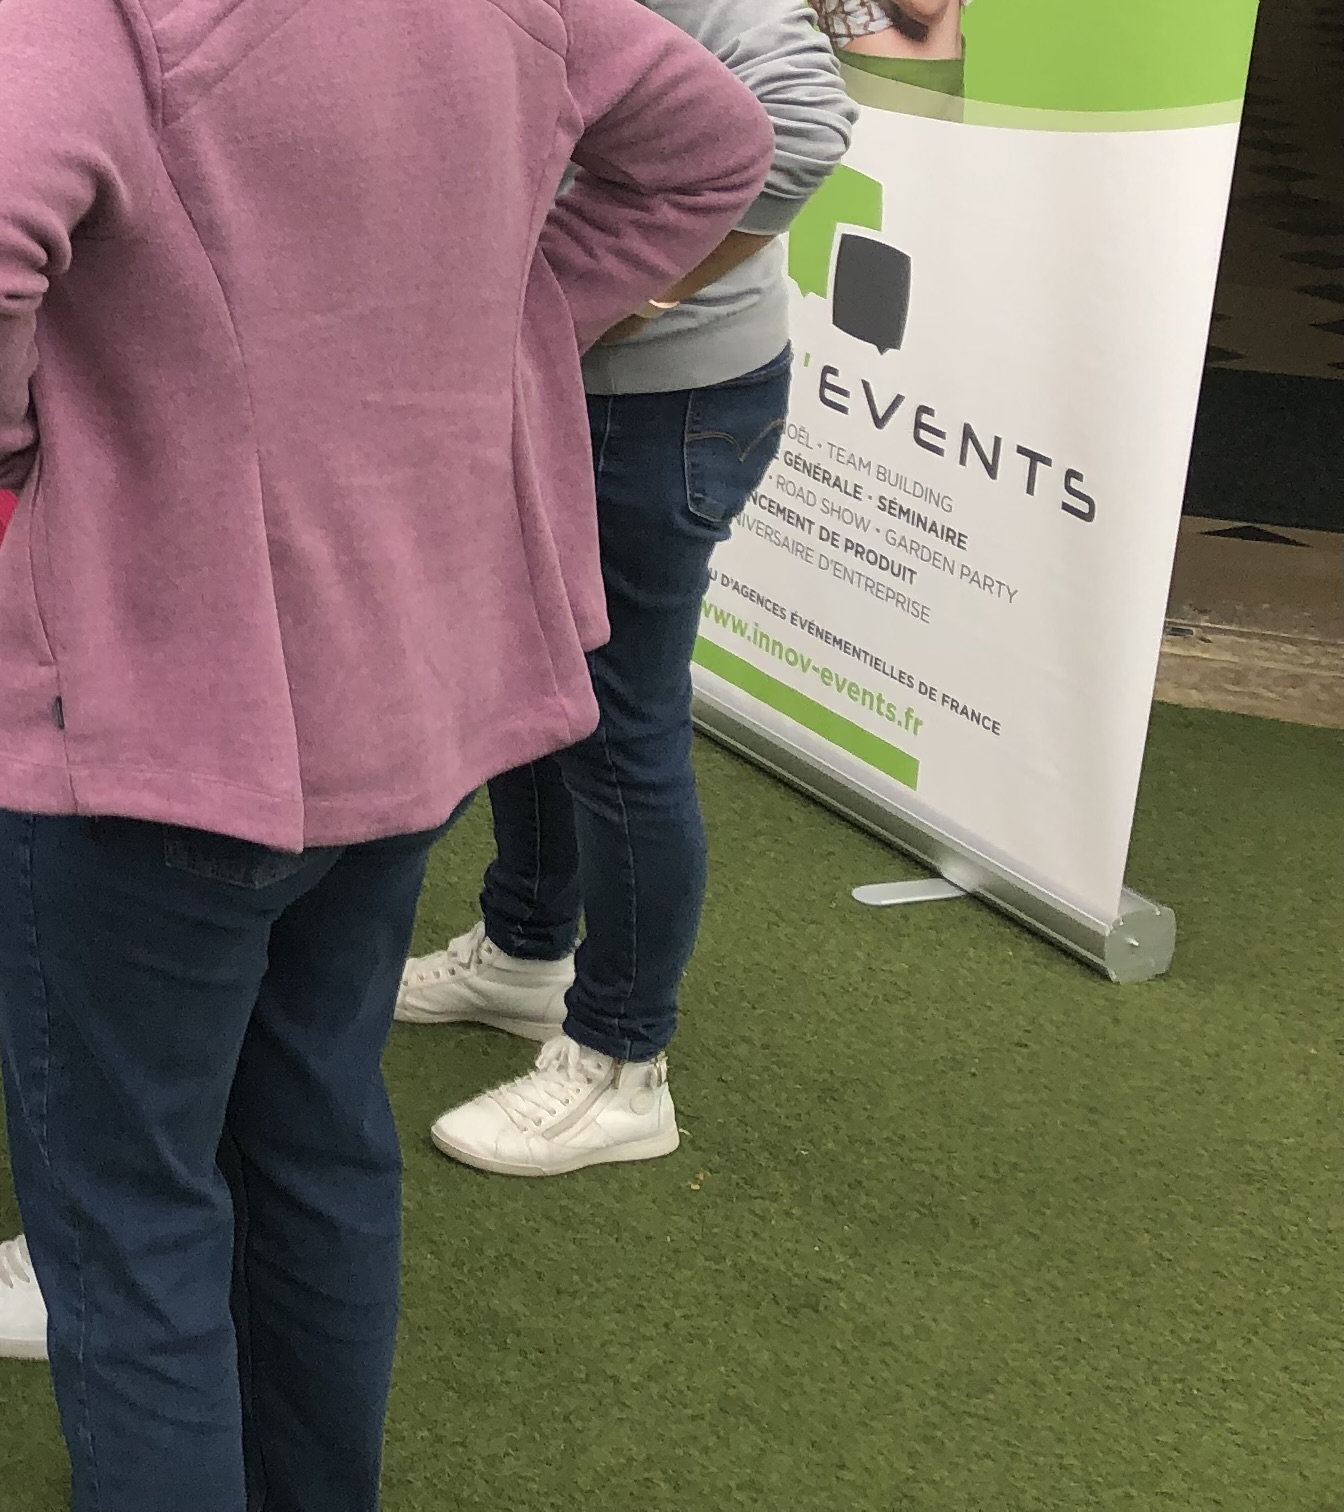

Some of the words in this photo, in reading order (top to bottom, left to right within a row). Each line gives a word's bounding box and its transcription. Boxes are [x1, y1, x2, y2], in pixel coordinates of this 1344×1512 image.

[784, 423, 814, 450] OËL
[827, 441, 872, 476] TEAM
[876, 464, 953, 513] BUILDING
[803, 352, 1097, 523] 'EVENTS
[748, 491, 816, 535] NCEMENT
[819, 524, 840, 549] DE
[844, 538, 918, 585] PRODUIT
[776, 473, 818, 508] ROAD
[820, 497, 872, 534] SHOW
[885, 528, 956, 576] GARDEN
[959, 563, 1019, 603] PARTY
[783, 450, 864, 502] GÉNÉRALE
[877, 495, 969, 551] SÉMINAIRE
[819, 553, 932, 624] D'ENTREPRISE
[720, 573, 787, 621] D'AGENCES
[918, 680, 938, 702] DE
[941, 693, 1002, 736] FRANCE
